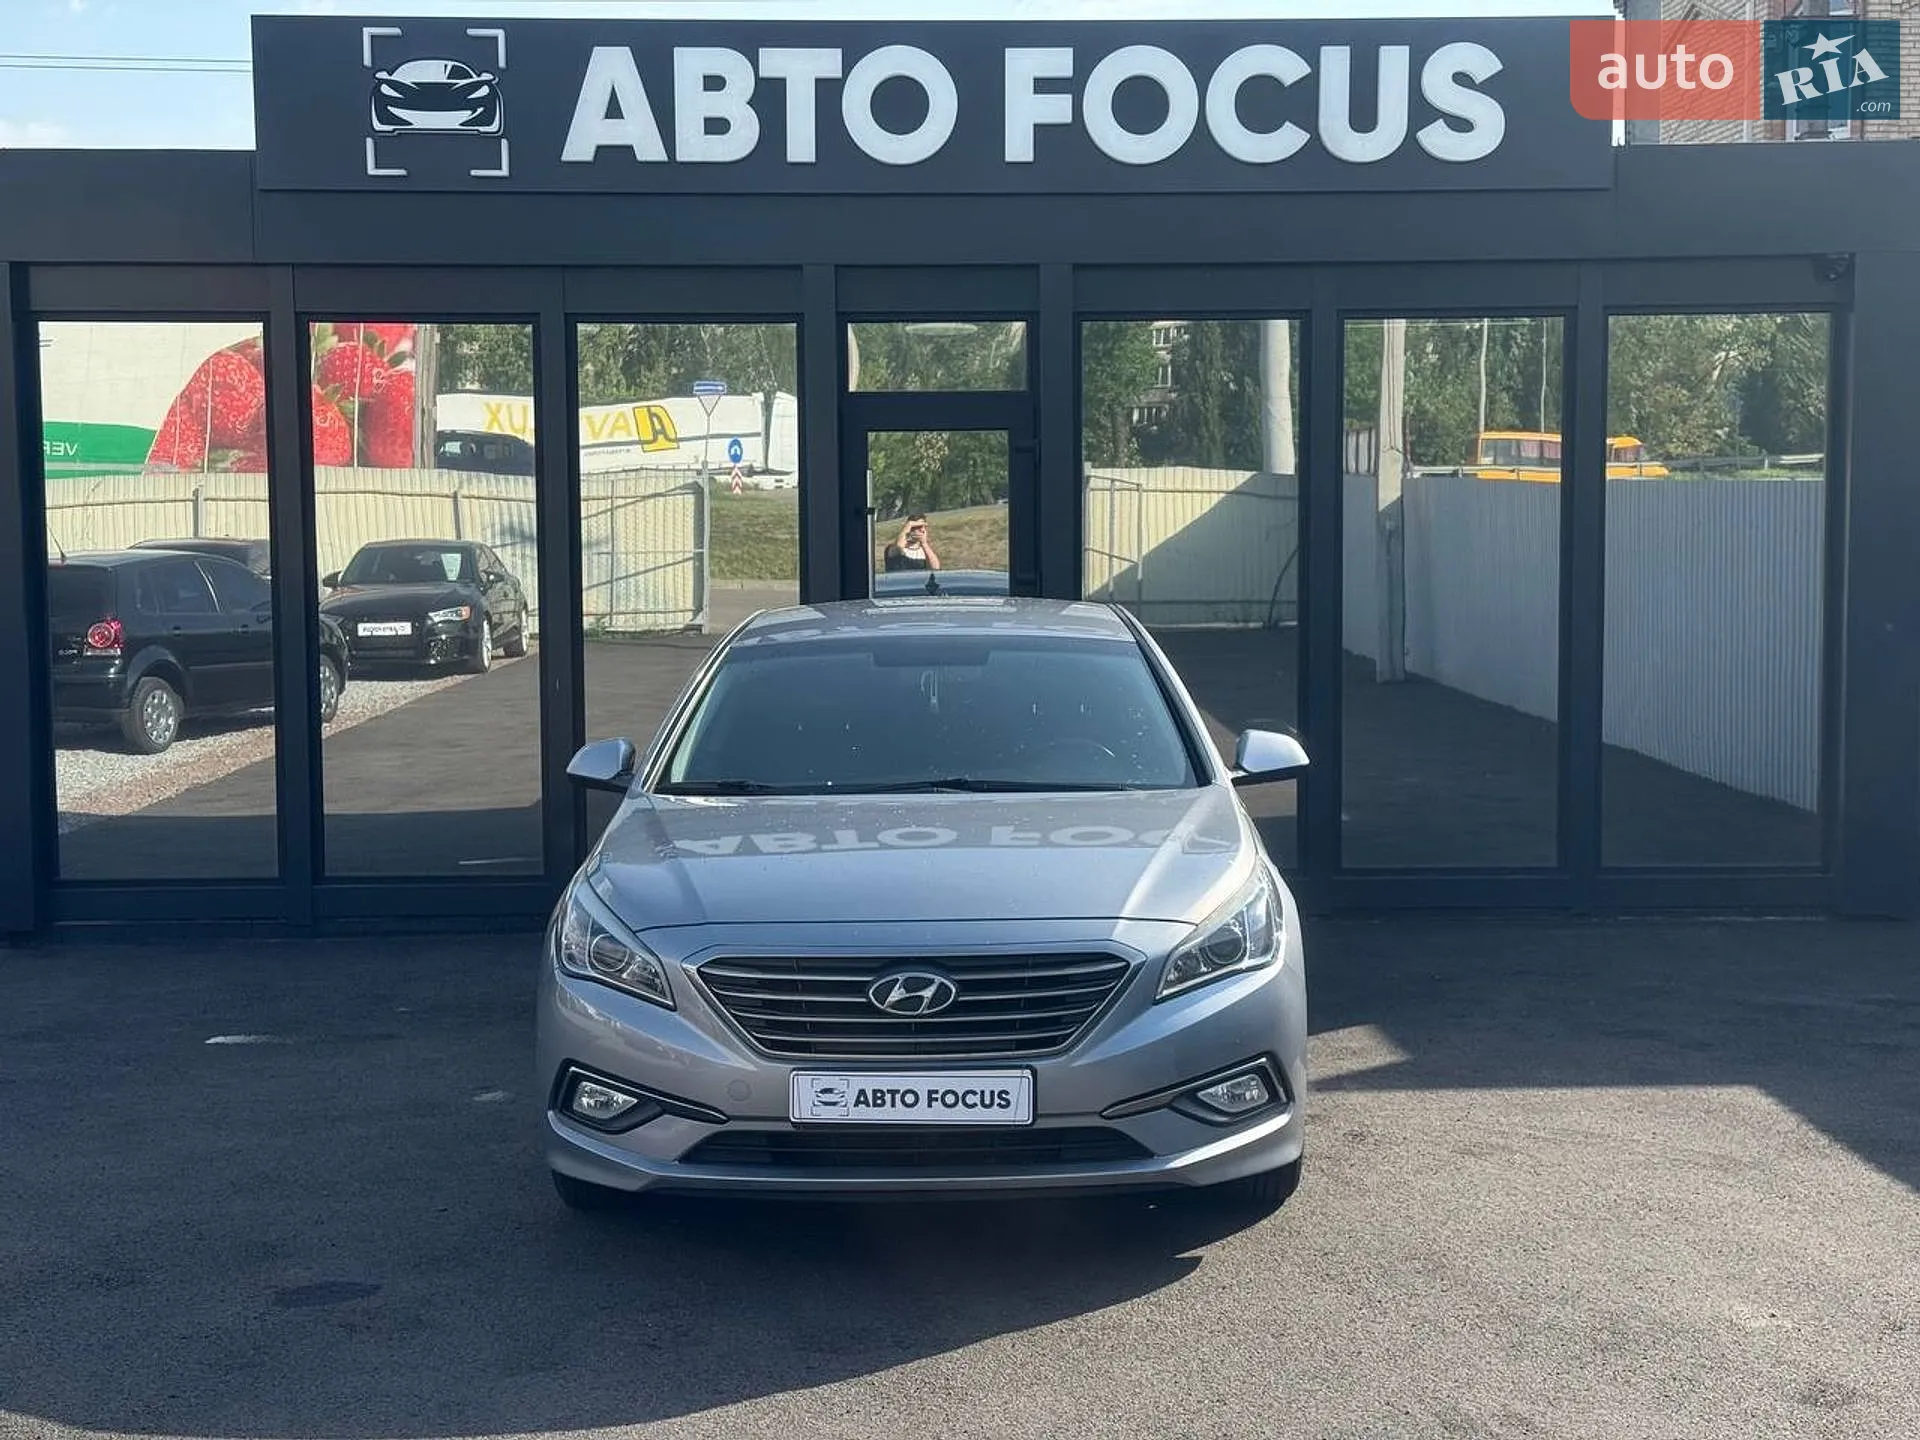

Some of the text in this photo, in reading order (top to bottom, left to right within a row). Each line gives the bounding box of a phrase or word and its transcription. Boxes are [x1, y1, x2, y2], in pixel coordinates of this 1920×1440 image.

[560, 42, 1506, 165] АВТО FOCUS
[853, 1089, 1012, 1110] АВТО FOCUS
